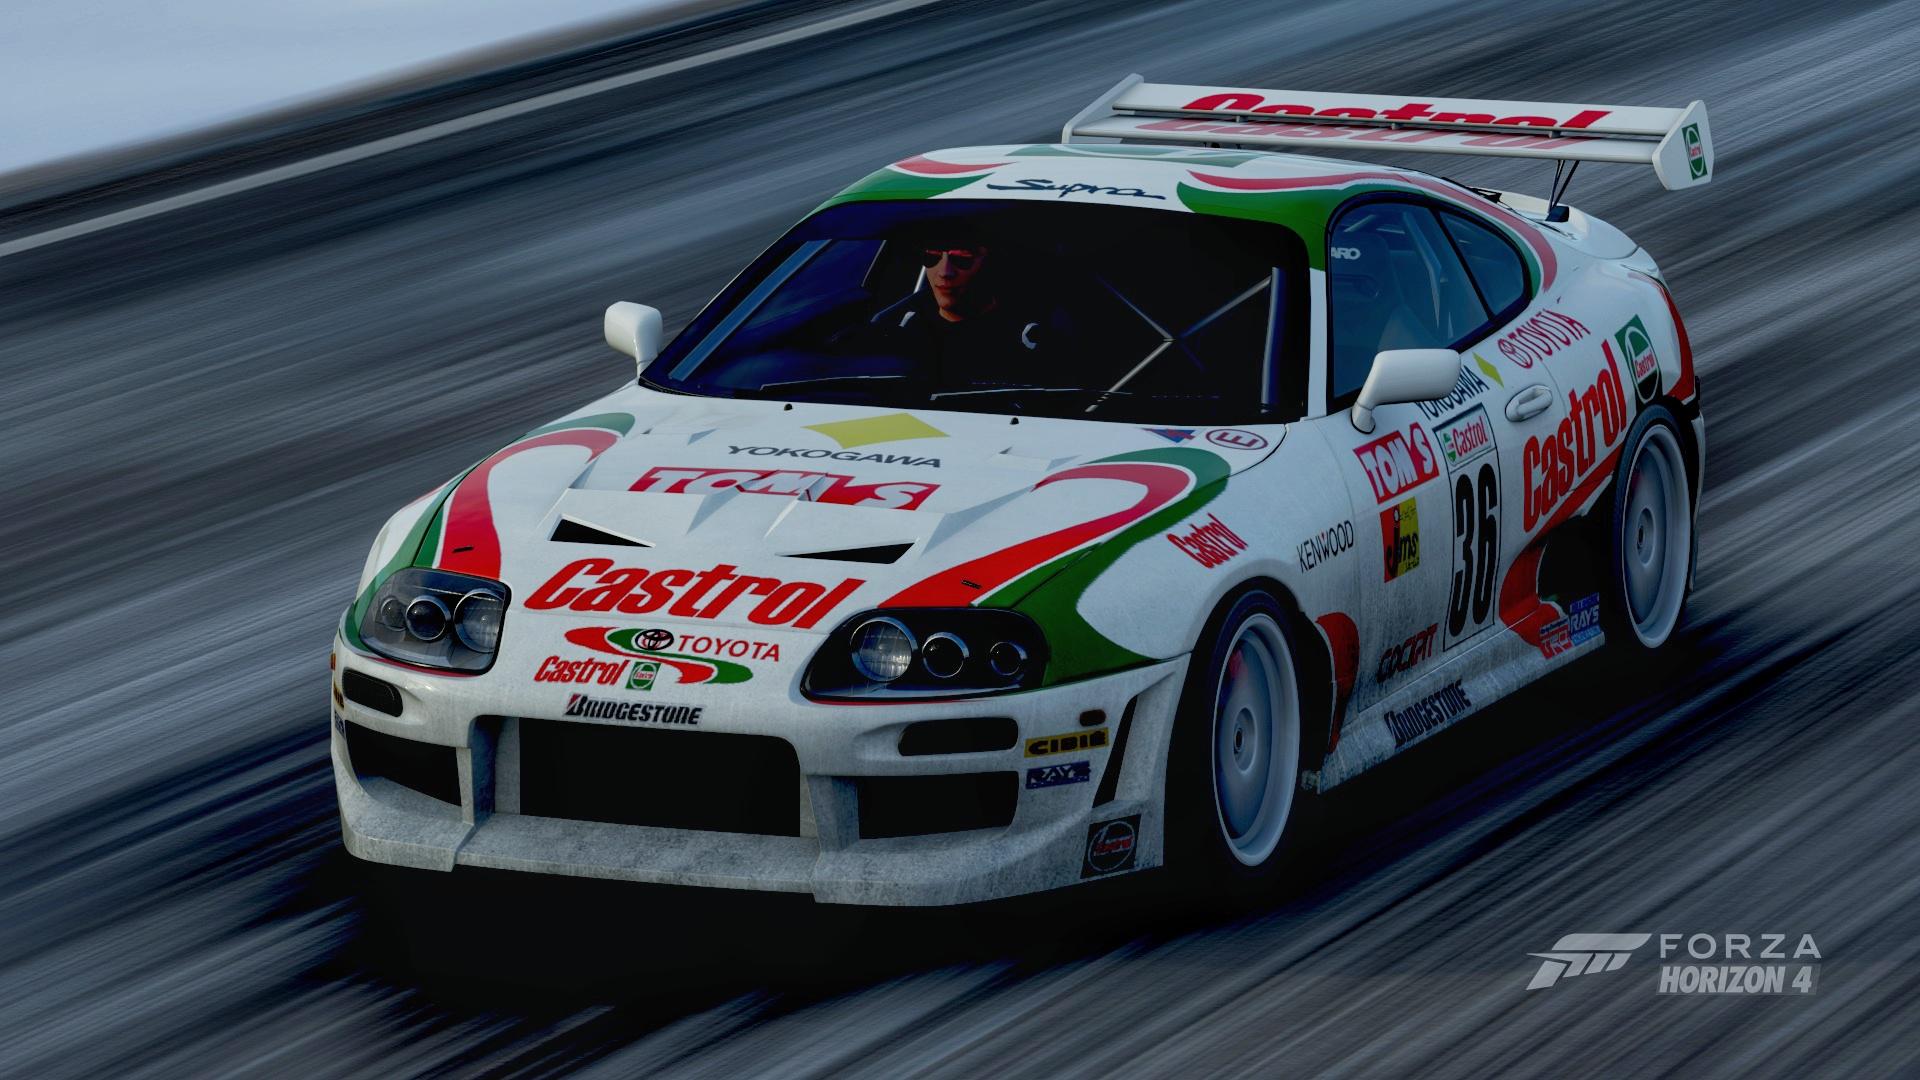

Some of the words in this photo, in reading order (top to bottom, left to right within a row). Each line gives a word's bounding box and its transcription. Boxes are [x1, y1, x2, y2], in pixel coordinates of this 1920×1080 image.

[986, 179, 1166, 200] Supra
[1506, 309, 1591, 369] TOYOTA
[727, 445, 941, 468] YOKOGAWA
[1452, 416, 1488, 457] Castrol
[1523, 339, 1626, 532] Castrol
[1167, 512, 1248, 568] Castrol
[1296, 520, 1354, 573] KENWOOD
[1449, 464, 1497, 637] 36
[524, 558, 866, 629] Castrol
[1570, 604, 1599, 633] RAYS
[534, 656, 630, 685] Castrol
[678, 635, 780, 662] TOYOTA
[565, 694, 702, 725] BRIDGESTONE
[1383, 679, 1471, 748] BRIDGESTONE
